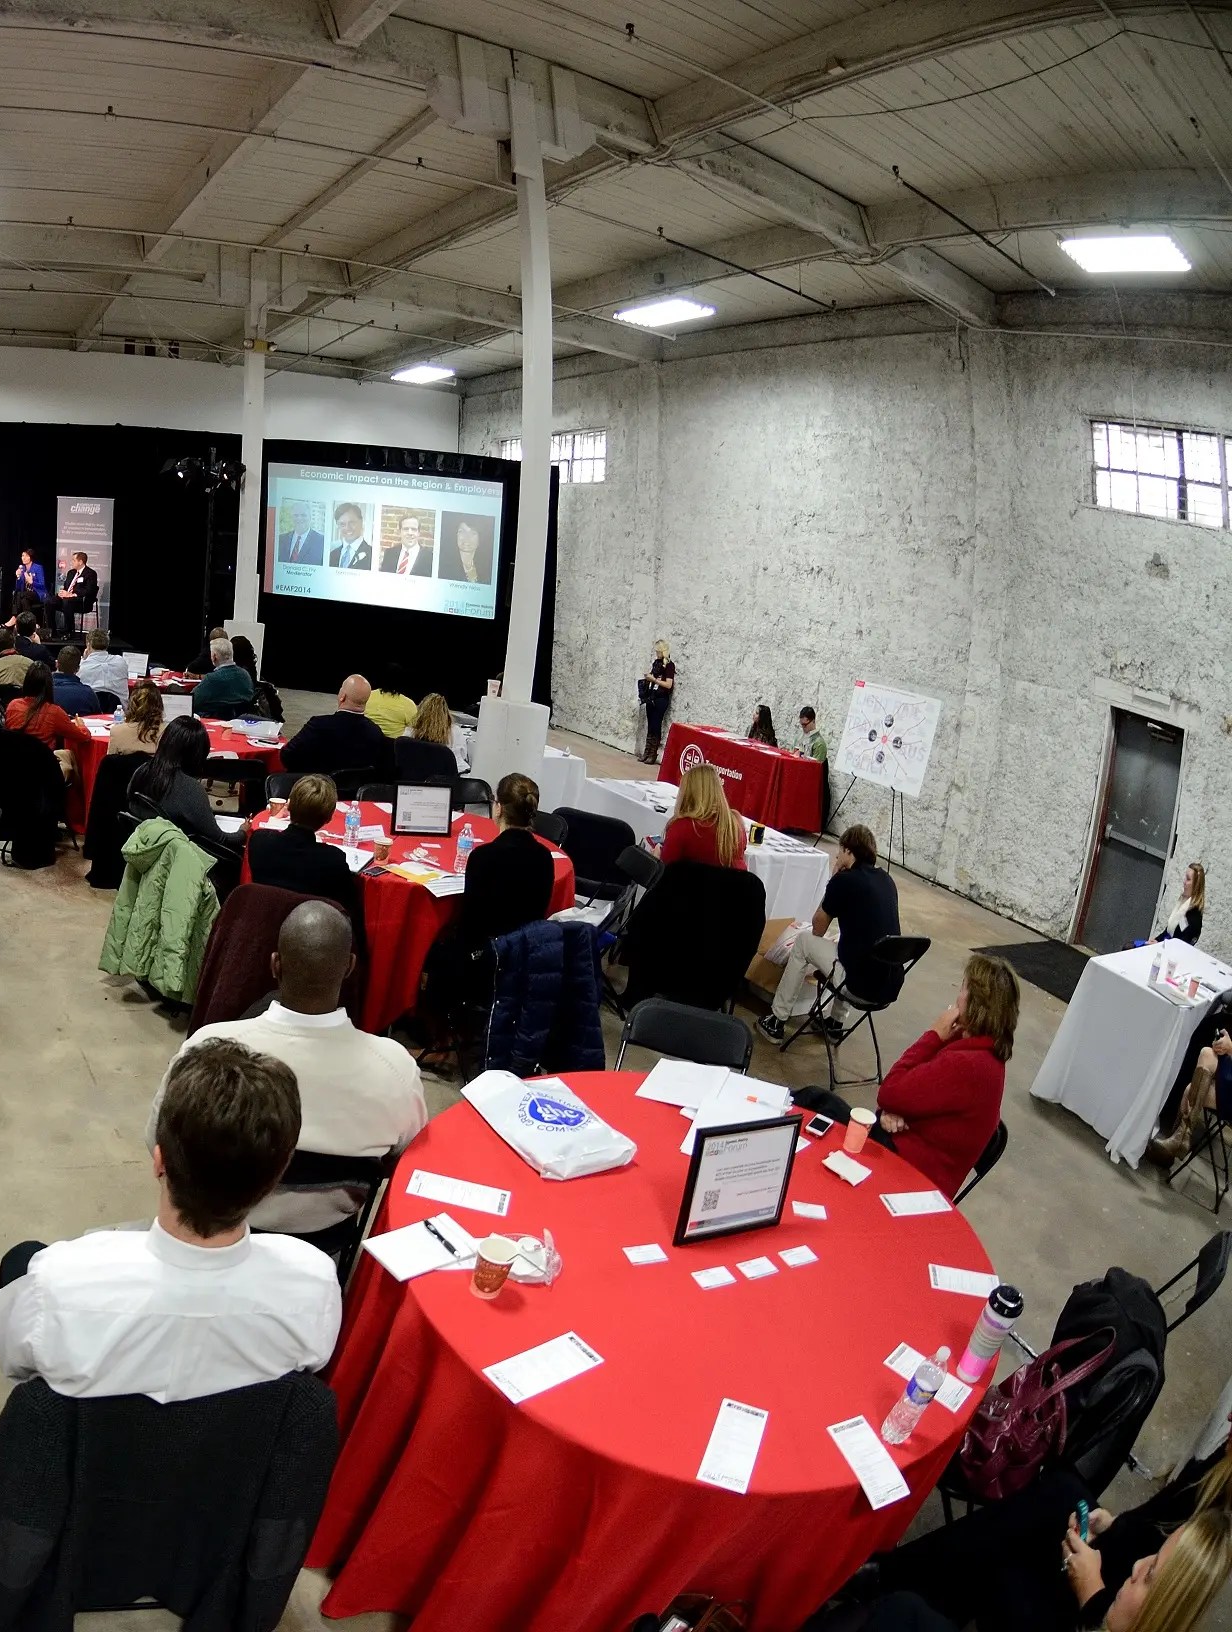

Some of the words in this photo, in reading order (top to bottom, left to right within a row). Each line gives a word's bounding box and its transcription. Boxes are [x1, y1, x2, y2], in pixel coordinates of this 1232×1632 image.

[300, 468, 344, 481] Economic
[346, 472, 379, 485] Impact
[380, 476, 393, 485] on
[394, 476, 409, 487] the
[411, 479, 443, 491] Region
[445, 482, 451, 490] &
[453, 483, 501, 497] Employers
[275, 584, 311, 595] #EMF2014
[705, 759, 743, 780] Tsportation
